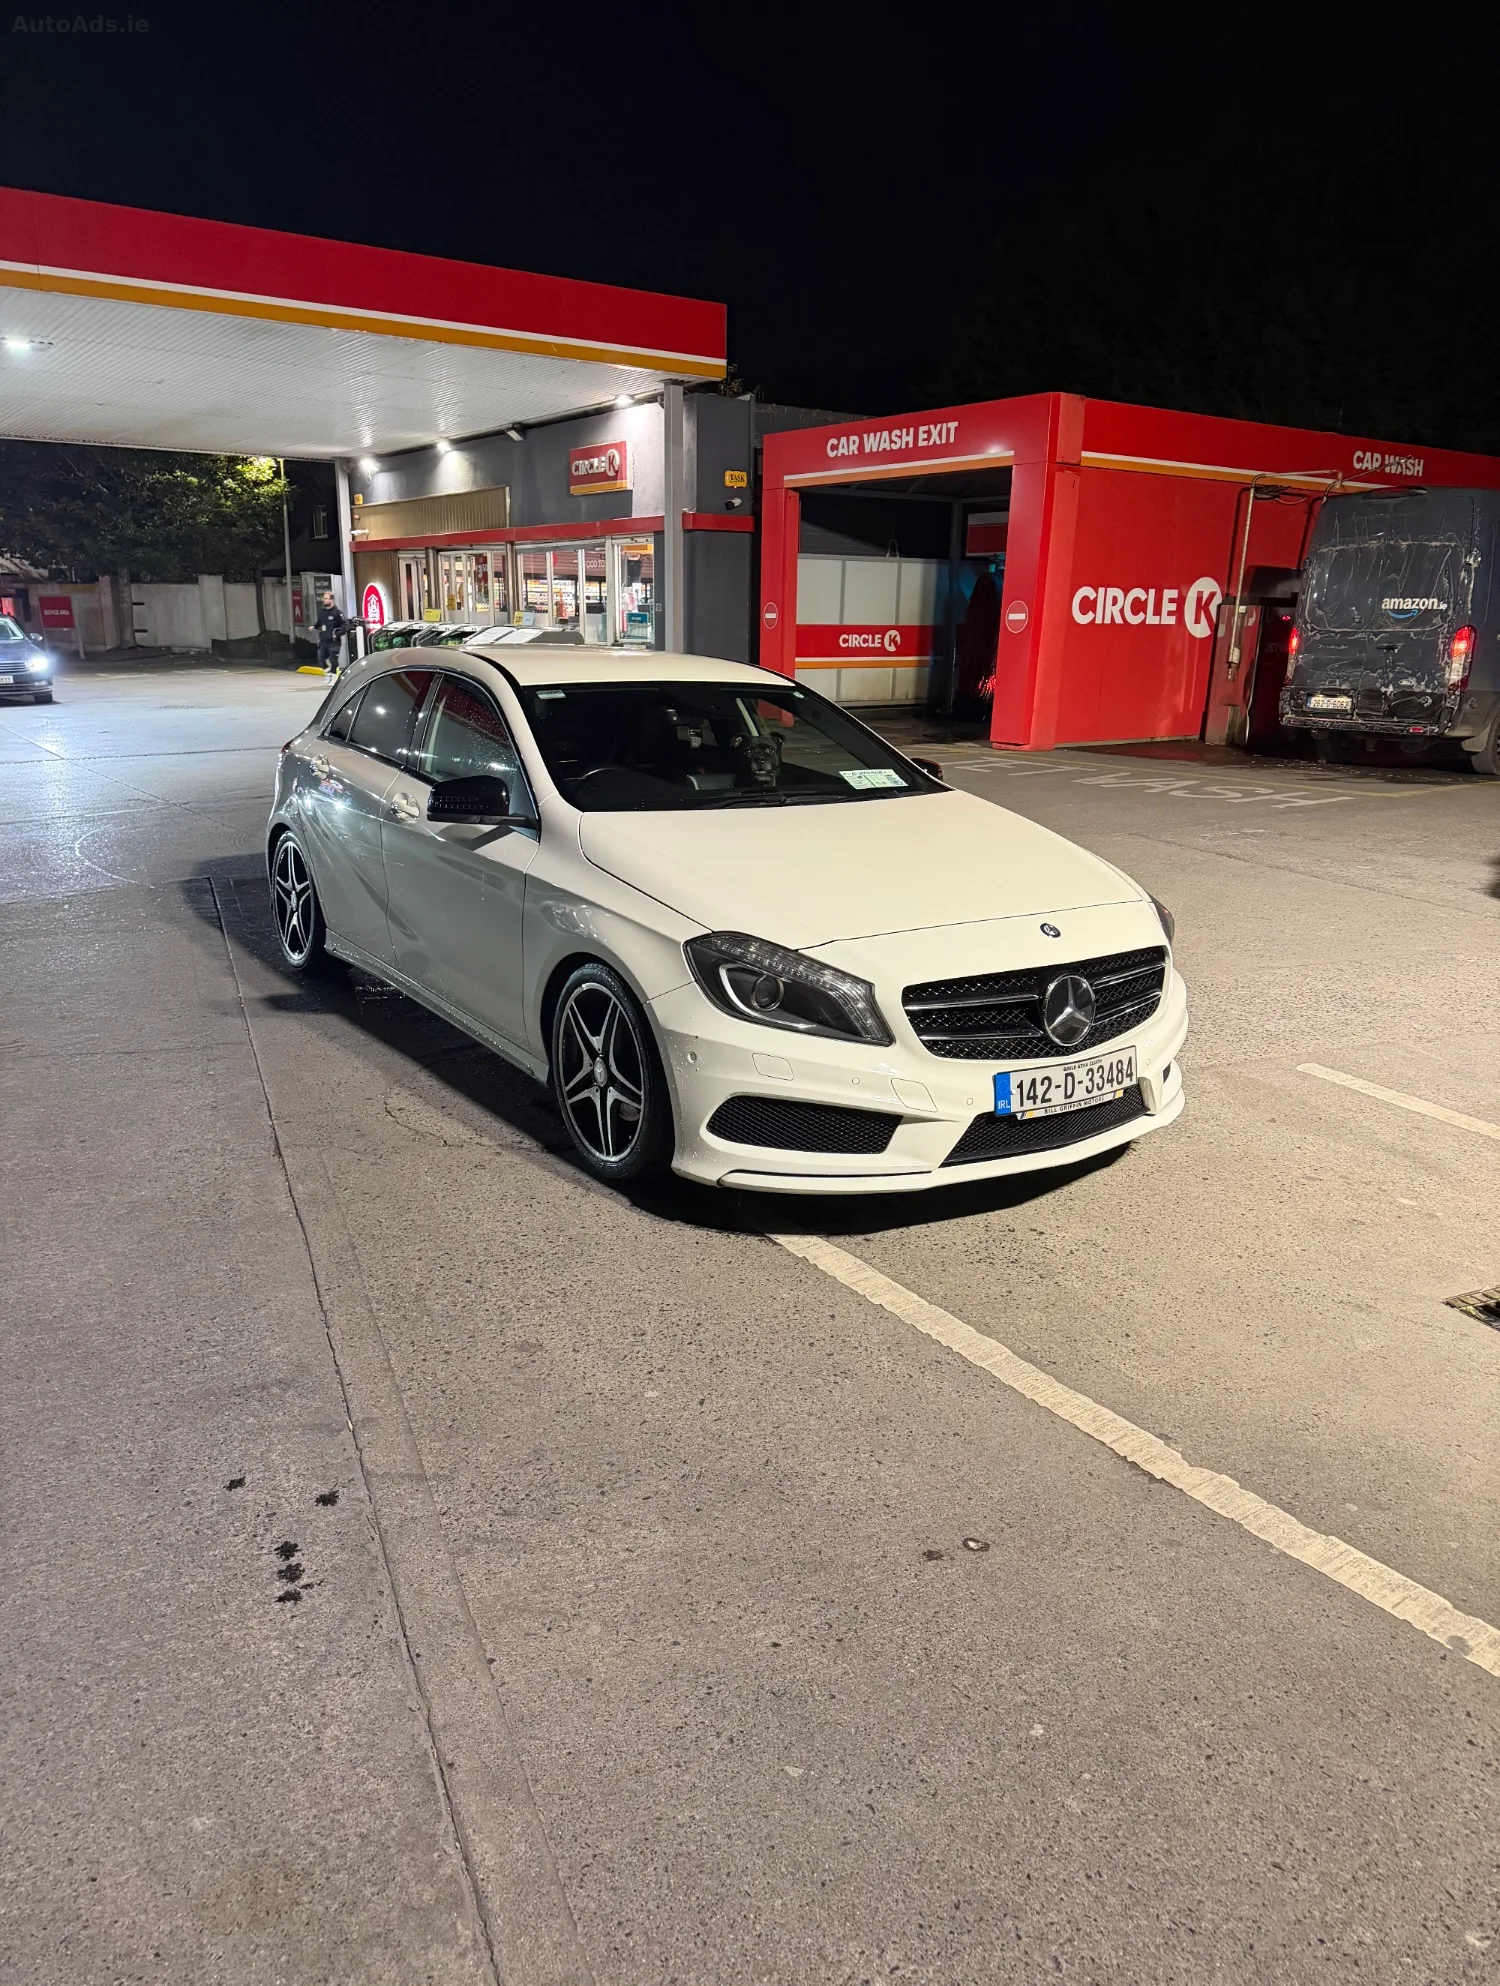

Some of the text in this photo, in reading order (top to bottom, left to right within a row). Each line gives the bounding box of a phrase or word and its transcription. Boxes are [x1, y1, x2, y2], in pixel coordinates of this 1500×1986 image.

[826, 421, 959, 458] CAR WASH EXIT
[571, 456, 606, 476] CIRCLE
[1384, 454, 1424, 477] WASH
[1072, 586, 1179, 625] CIRCLE
[1381, 597, 1448, 610] amazon.ie
[839, 633, 882, 648] CIRCLE
[1071, 772, 1354, 808] WASH
[1016, 1055, 1134, 1108] 142-D-33484
[997, 1099, 1011, 1110] IRL
[1044, 1107, 1058, 1115] BILL
[1083, 1095, 1105, 1107] MOTORS
